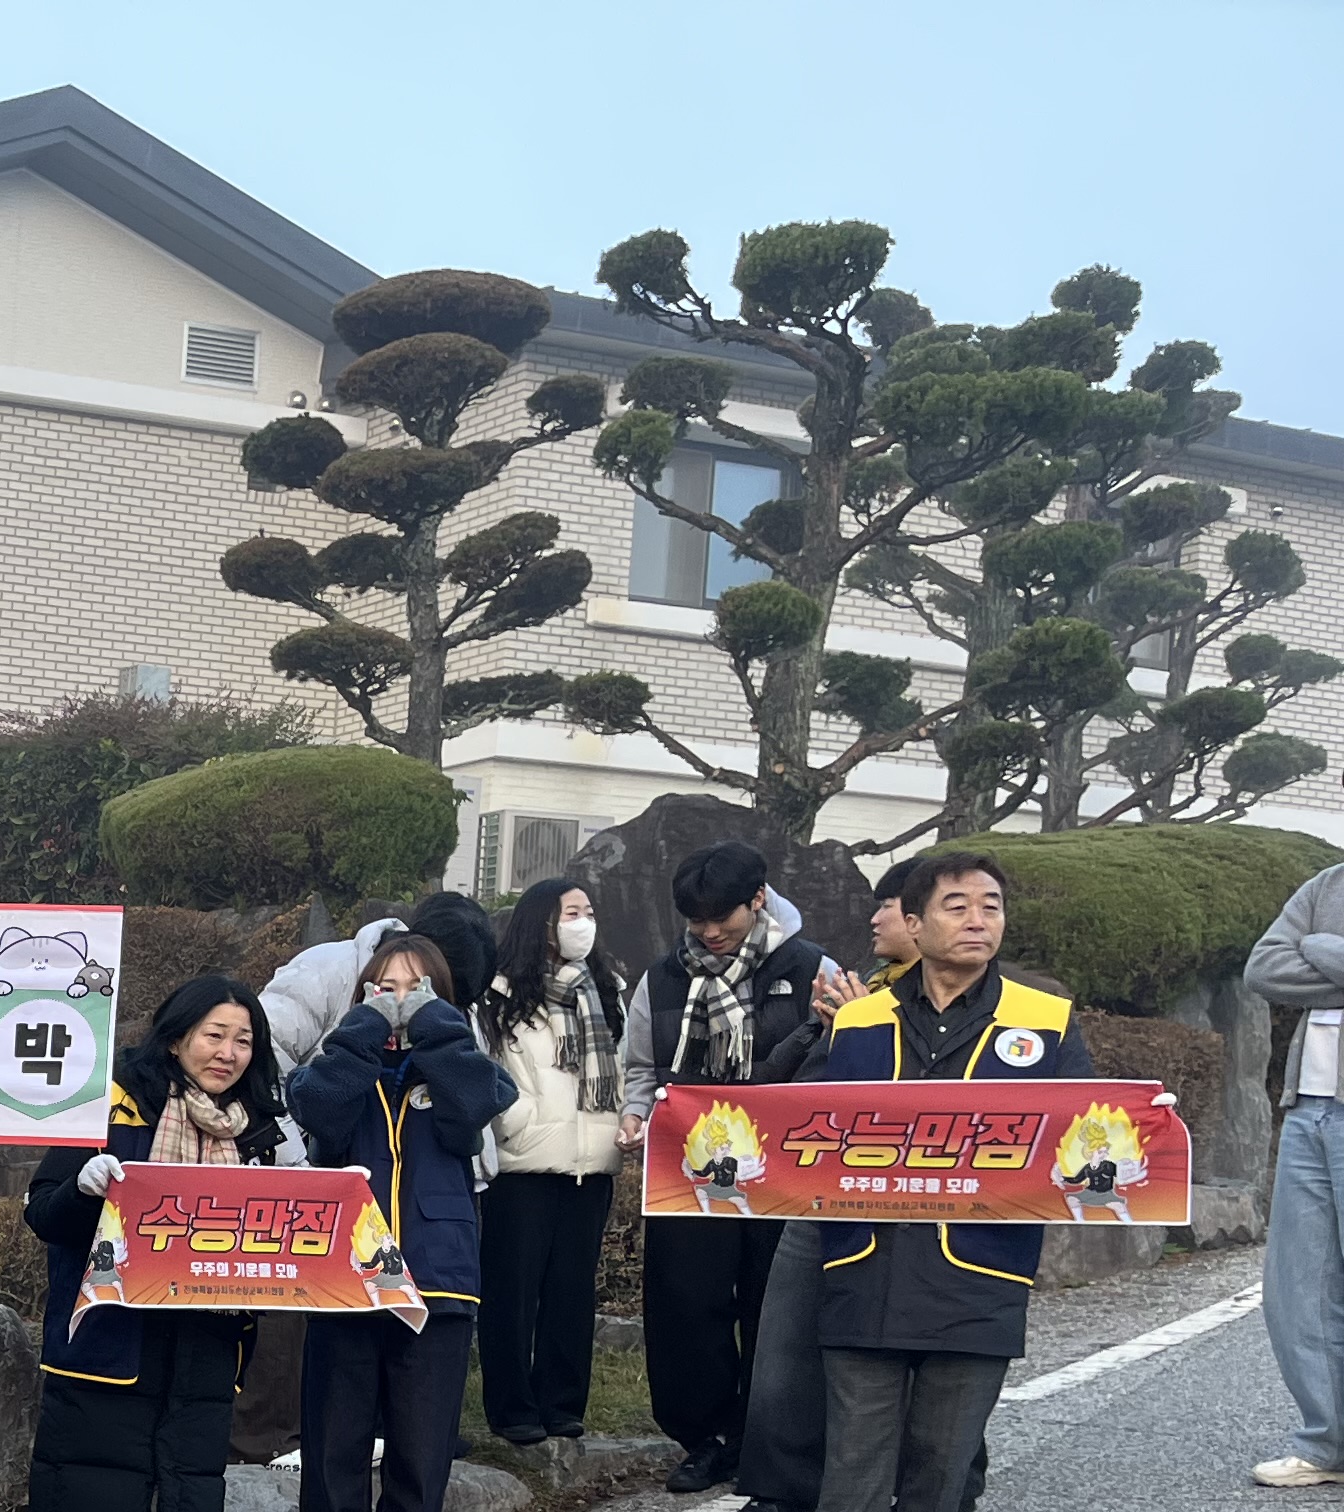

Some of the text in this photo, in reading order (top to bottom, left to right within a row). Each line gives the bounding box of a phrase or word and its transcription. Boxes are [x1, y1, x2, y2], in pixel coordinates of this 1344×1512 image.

[780, 1111, 1050, 1171] 수능만점
[838, 1176, 980, 1195] 우주의 기운을 모아
[135, 1195, 343, 1257] 수능만점
[189, 1261, 299, 1279] 우주의 기운을 모아
